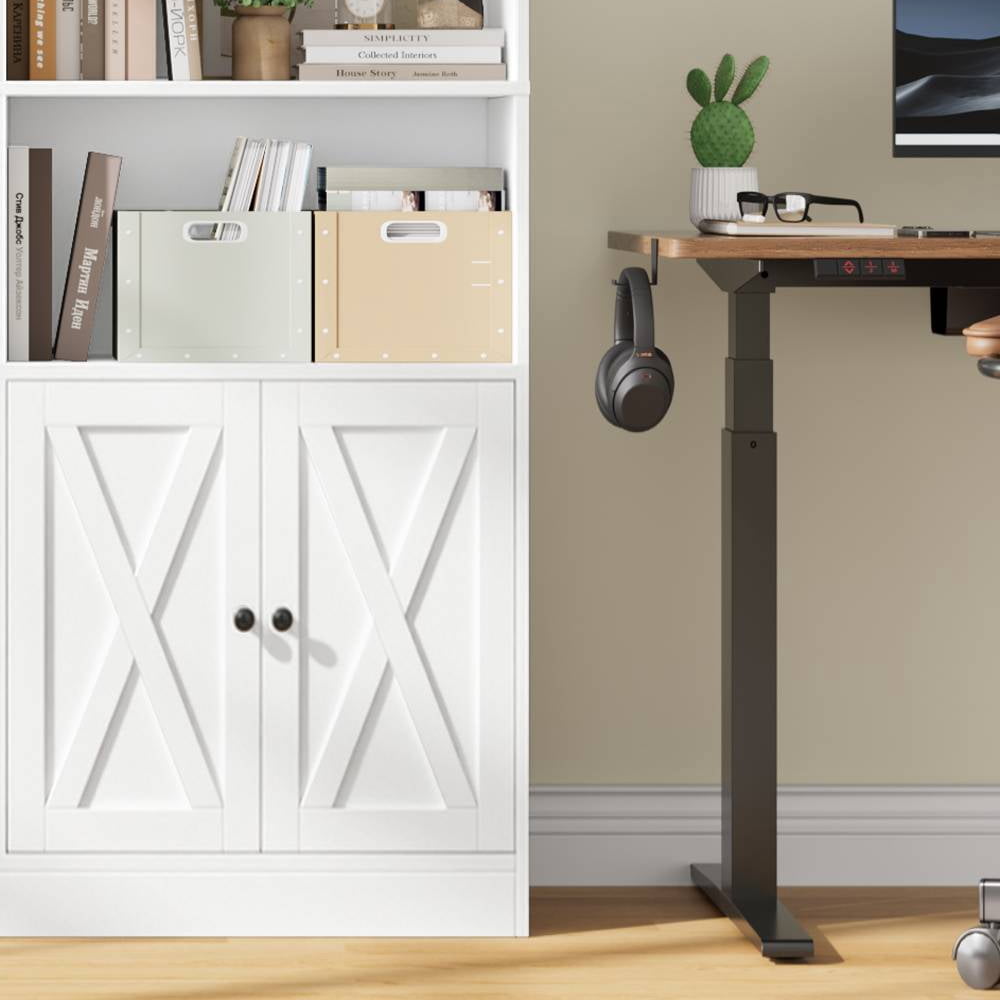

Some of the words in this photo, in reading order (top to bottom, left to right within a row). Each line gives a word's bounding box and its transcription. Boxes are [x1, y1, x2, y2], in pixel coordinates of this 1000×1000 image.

[34, 30, 46, 46] we
[34, 50, 46, 69] see
[358, 50, 398, 60] Collected
[402, 50, 437, 60] Interiors
[336, 69, 367, 80] House
[370, 69, 397, 80] Story
[15, 192, 24, 214] Стив
[15, 216, 24, 245] Джобс
[77, 248, 98, 294] Мартин
[71, 298, 90, 330] Иден
